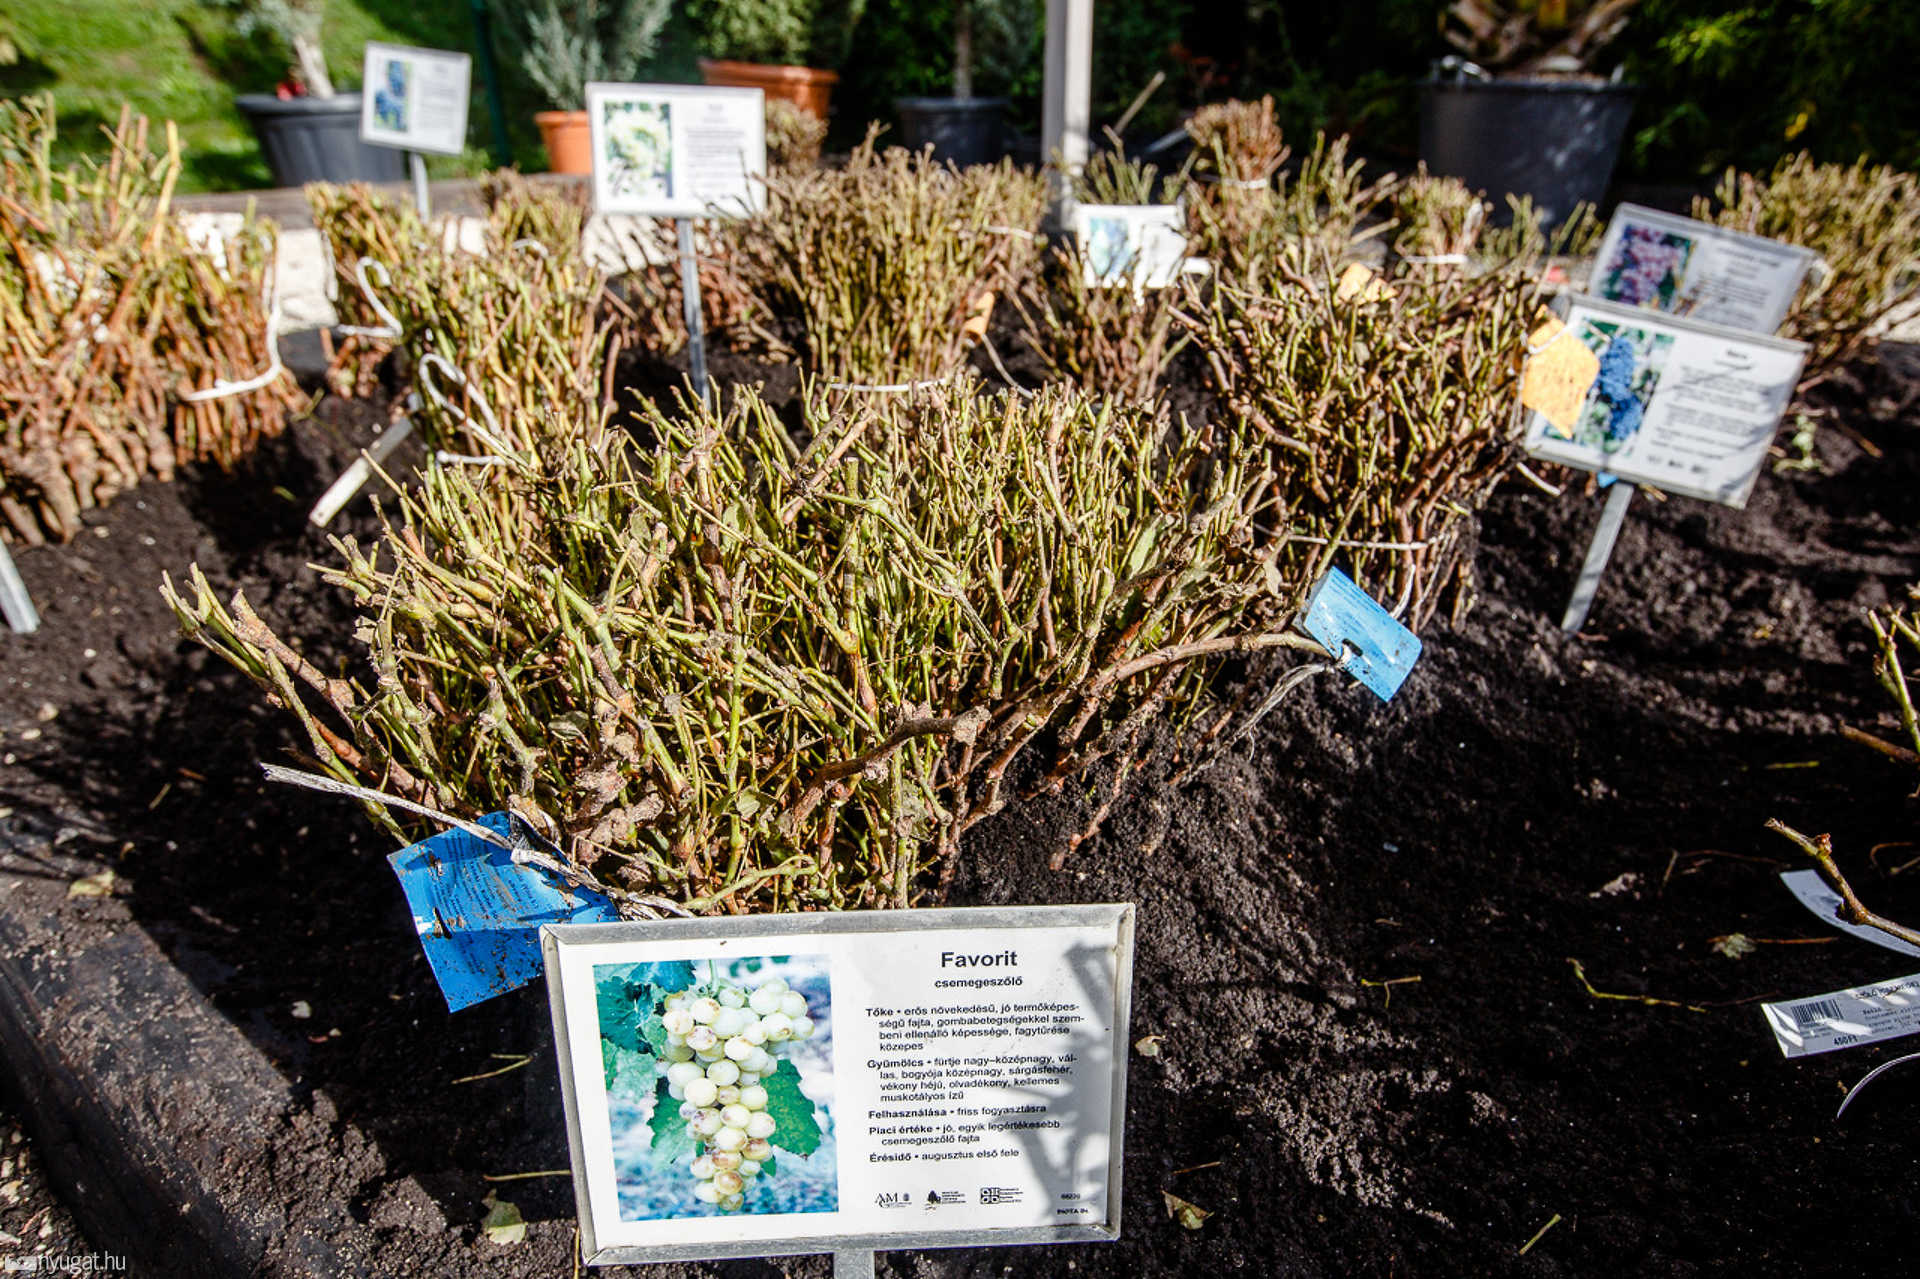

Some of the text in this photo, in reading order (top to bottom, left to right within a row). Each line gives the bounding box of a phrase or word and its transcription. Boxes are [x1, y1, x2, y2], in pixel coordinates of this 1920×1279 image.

[942, 951, 1017, 967] Favorit
[934, 976, 1023, 989] csemegeszőlő
[866, 1007, 893, 1016] Tőke
[904, 1006, 927, 1015] erős
[1001, 1003, 1011, 1014] jó
[1014, 1002, 1079, 1012] termőképes-
[908, 1018, 933, 1028] fajta,
[937, 1015, 1049, 1027] gombabetegségekkel
[1053, 1015, 1084, 1023] szem-
[879, 1030, 902, 1039] beni
[905, 1030, 948, 1039] ellenálló
[880, 1042, 924, 1052] közepes
[867, 1059, 923, 1070] Gyümölcs
[934, 1057, 961, 1067] fürtje
[1059, 1054, 1077, 1062] vál-
[901, 1069, 943, 1080] bogyója
[880, 1082, 917, 1092] vékony
[1014, 1077, 1059, 1086] kellemes
[880, 1092, 945, 1102] muskotályos
[868, 1105, 1047, 1119] Felhasználása friss fogyasztásra
[869, 1126, 896, 1135] Piaci
[899, 1125, 933, 1134] értéke
[958, 1123, 985, 1133] egyik
[988, 1120, 1060, 1131] legértékesebb
[881, 1135, 980, 1145] csemegeszőlő fajta
[869, 1152, 911, 1162] Érésidő
[922, 1151, 974, 1161] augusztus
[976, 1149, 998, 1158] első
